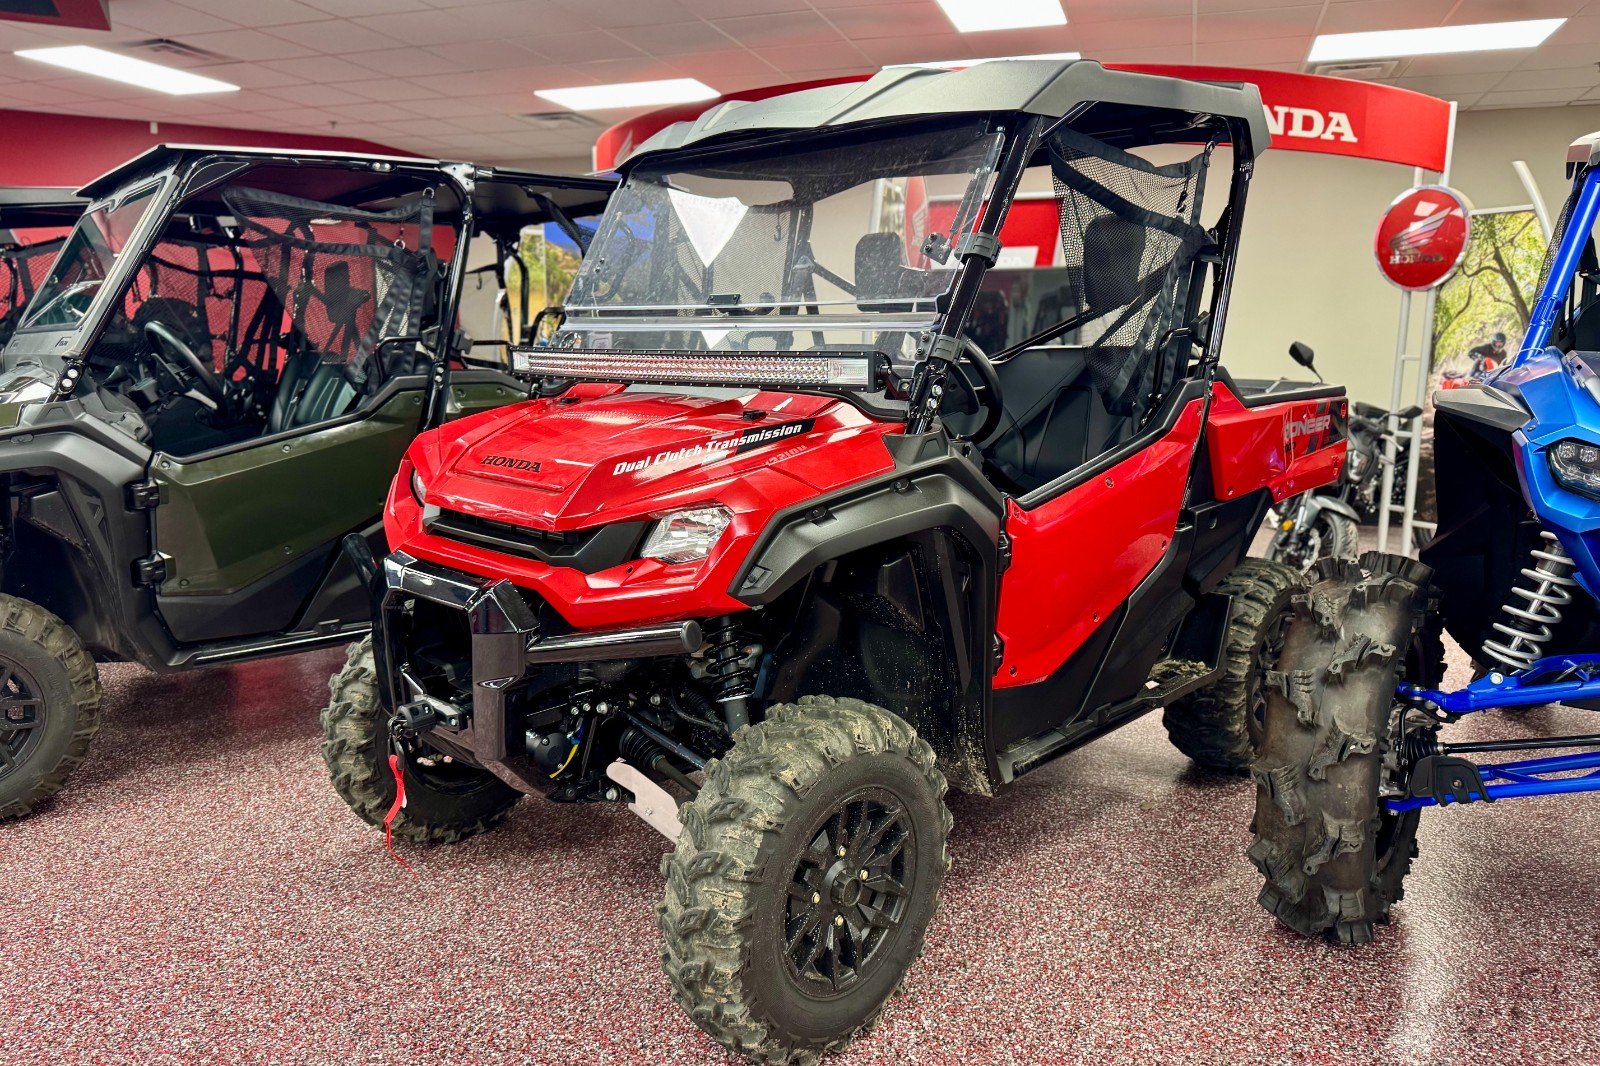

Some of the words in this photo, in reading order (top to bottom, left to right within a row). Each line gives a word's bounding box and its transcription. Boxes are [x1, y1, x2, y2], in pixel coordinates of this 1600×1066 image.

[1389, 254, 1445, 265] HONDA
[612, 455, 651, 476] Dual
[652, 444, 701, 466] Clutch
[705, 424, 802, 452] Transmission
[481, 455, 541, 473] HONDA
